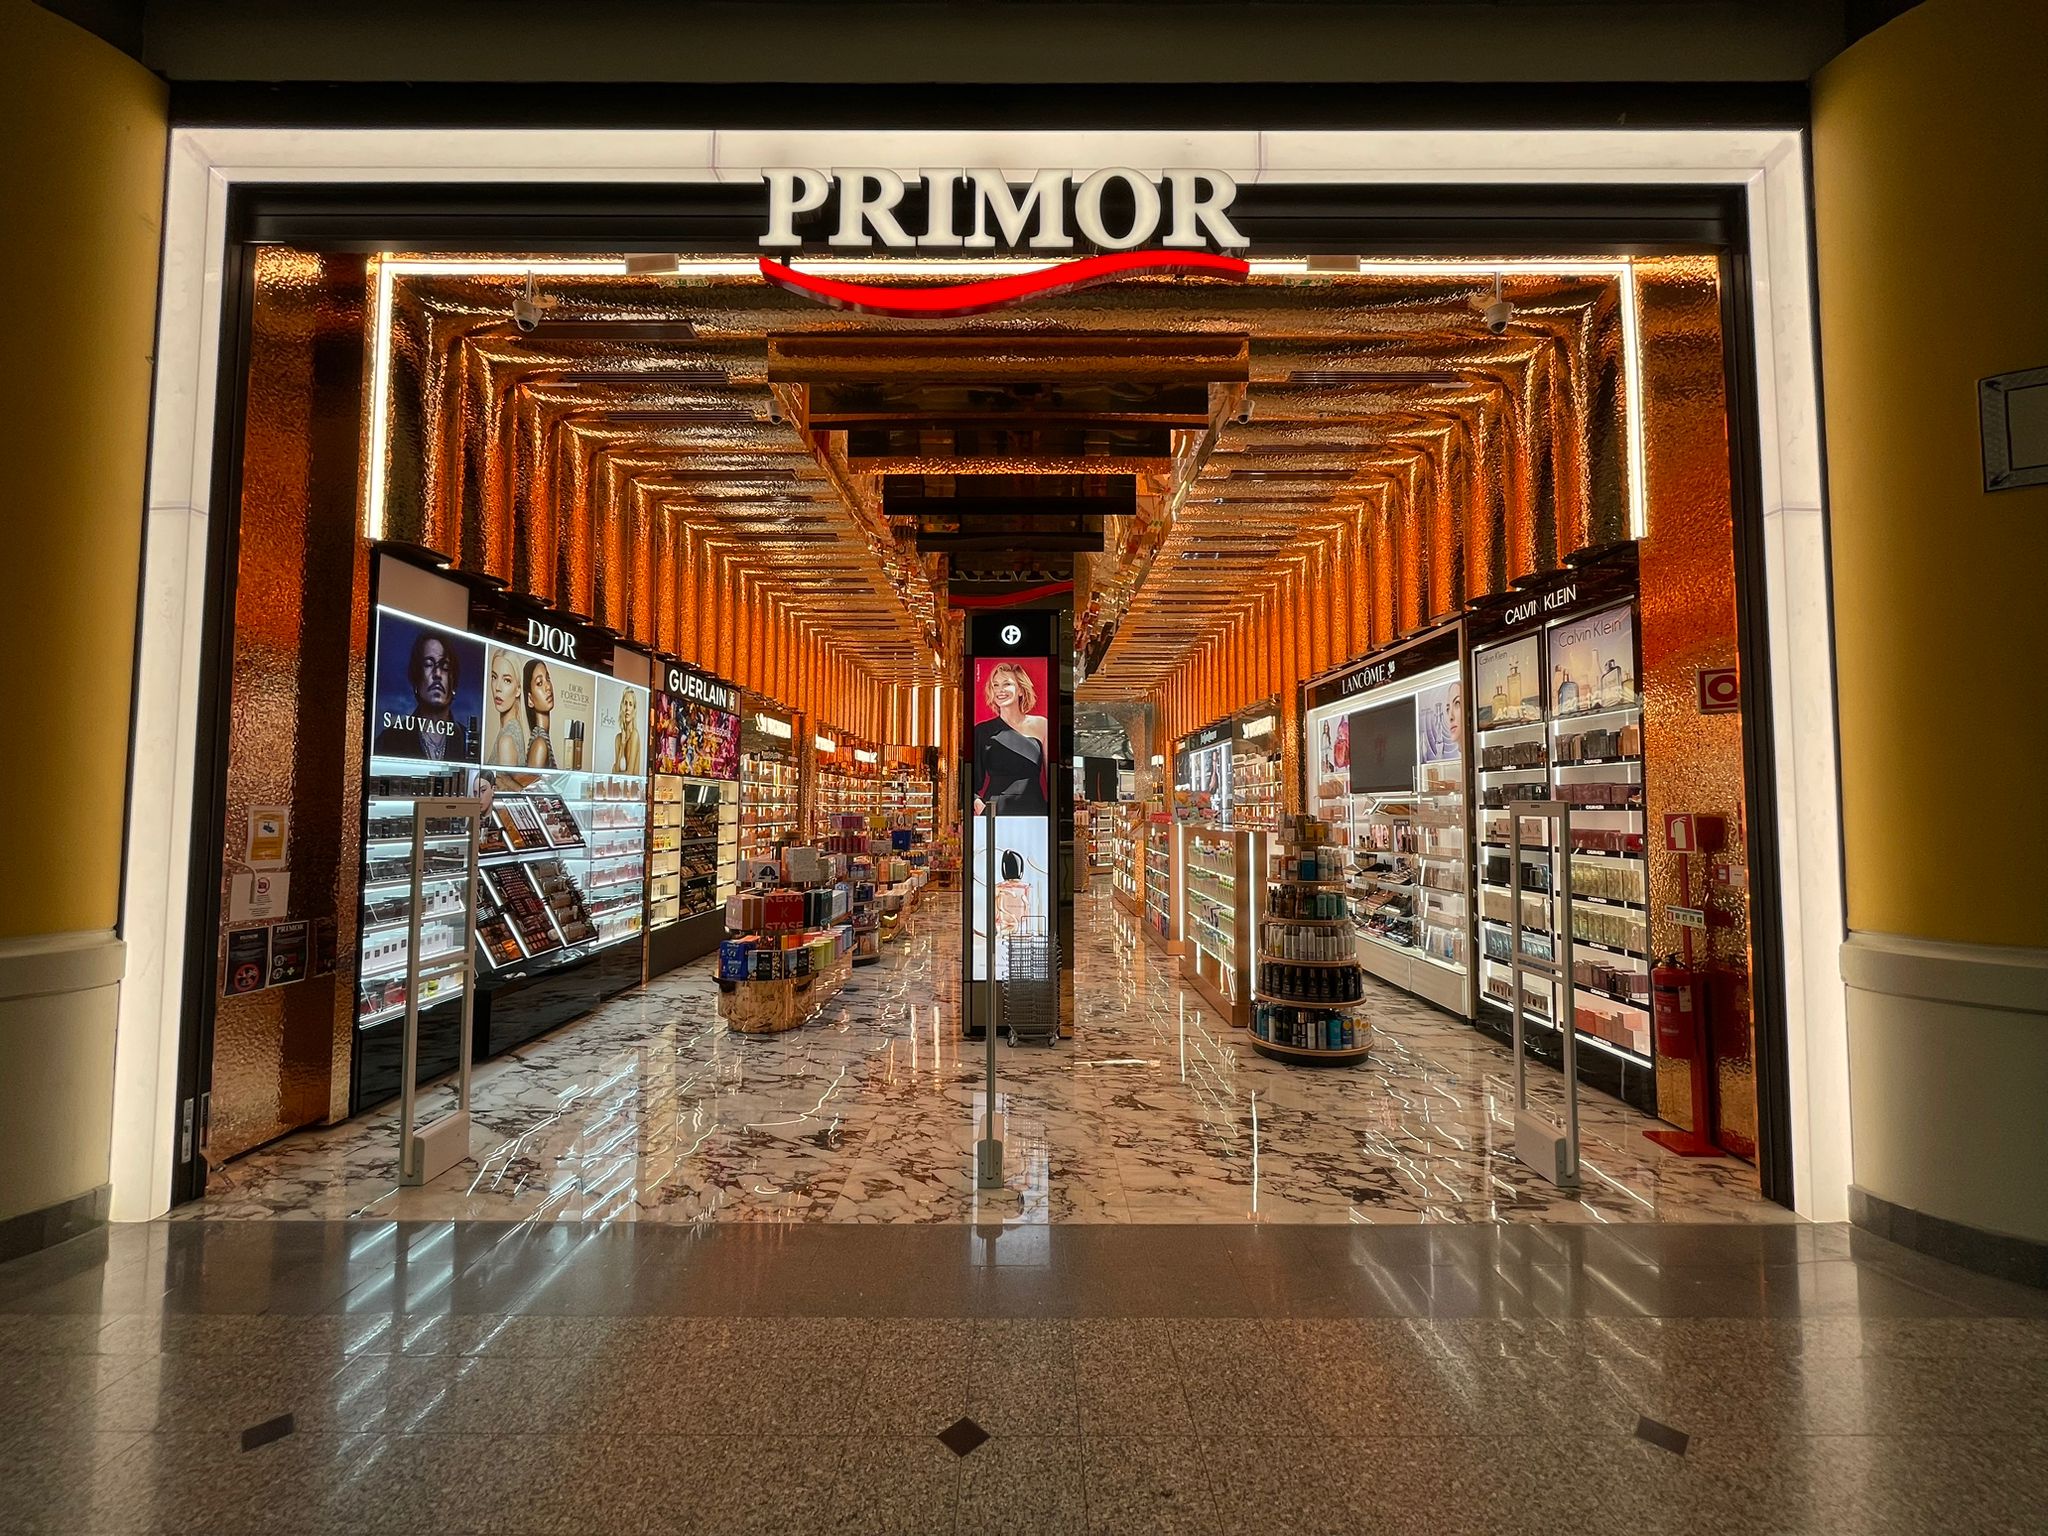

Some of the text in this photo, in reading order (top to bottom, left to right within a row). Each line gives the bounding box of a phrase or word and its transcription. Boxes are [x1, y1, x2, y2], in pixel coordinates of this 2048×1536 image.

[759, 167, 1251, 249] PRIMOR
[1505, 584, 1577, 625] CALVIN KLEIN
[527, 618, 576, 660] DIOR
[1558, 619, 1622, 648] Calvin Klein
[669, 669, 727, 708] GUERLAIN
[1342, 664, 1386, 695] LANCÔME
[383, 711, 455, 736] SAUVAGE
